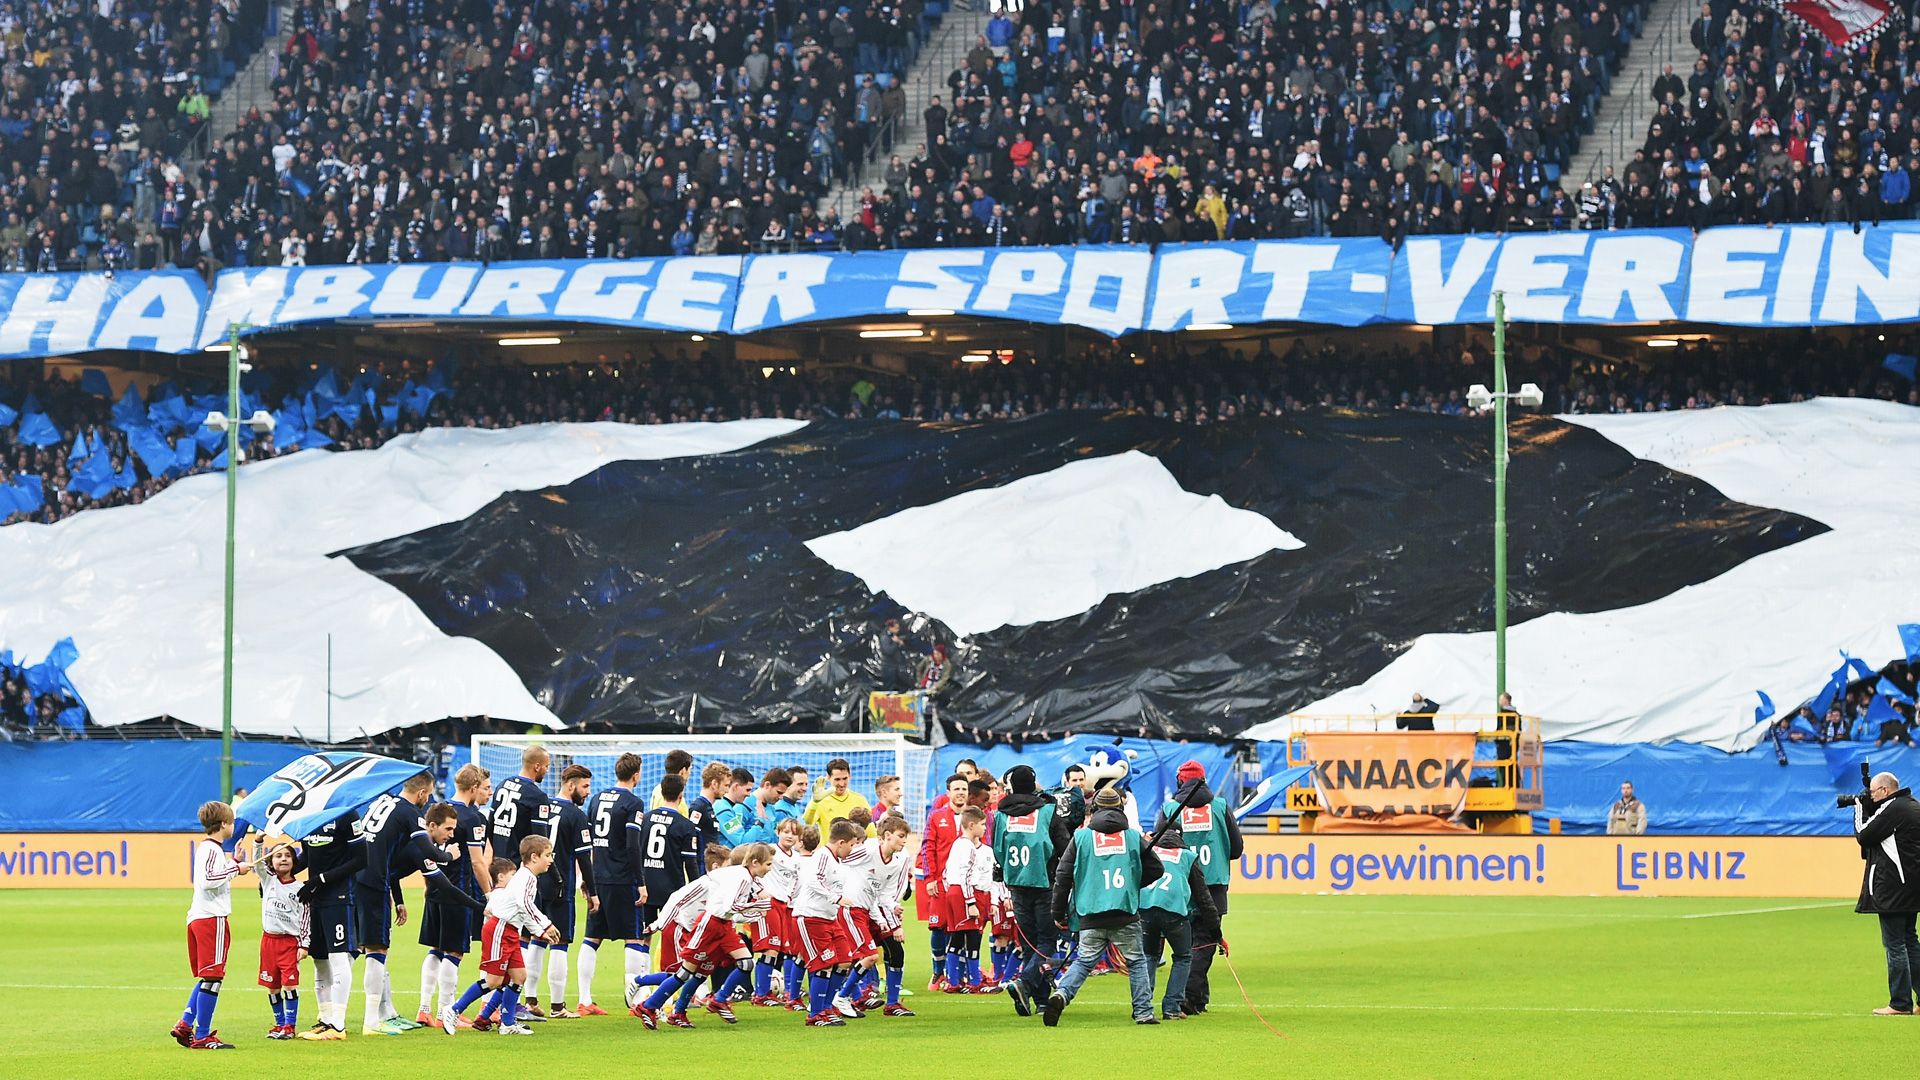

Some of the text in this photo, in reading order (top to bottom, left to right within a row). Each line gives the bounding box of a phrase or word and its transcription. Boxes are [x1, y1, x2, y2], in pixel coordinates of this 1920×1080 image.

[0, 226, 1920, 354] HAMBURGER SPORT-VEREIN
[1314, 758, 1471, 790] KNAACK
[362, 796, 397, 833] 19
[493, 787, 522, 828] 25
[594, 800, 614, 838] 5
[646, 823, 667, 859] 6
[1008, 845, 1030, 867] 30
[1102, 867, 1125, 890] 16
[1240, 843, 1546, 891] und gewinnen!
[1616, 843, 1747, 891] LEIBNIZ
[335, 924, 345, 940] 8
